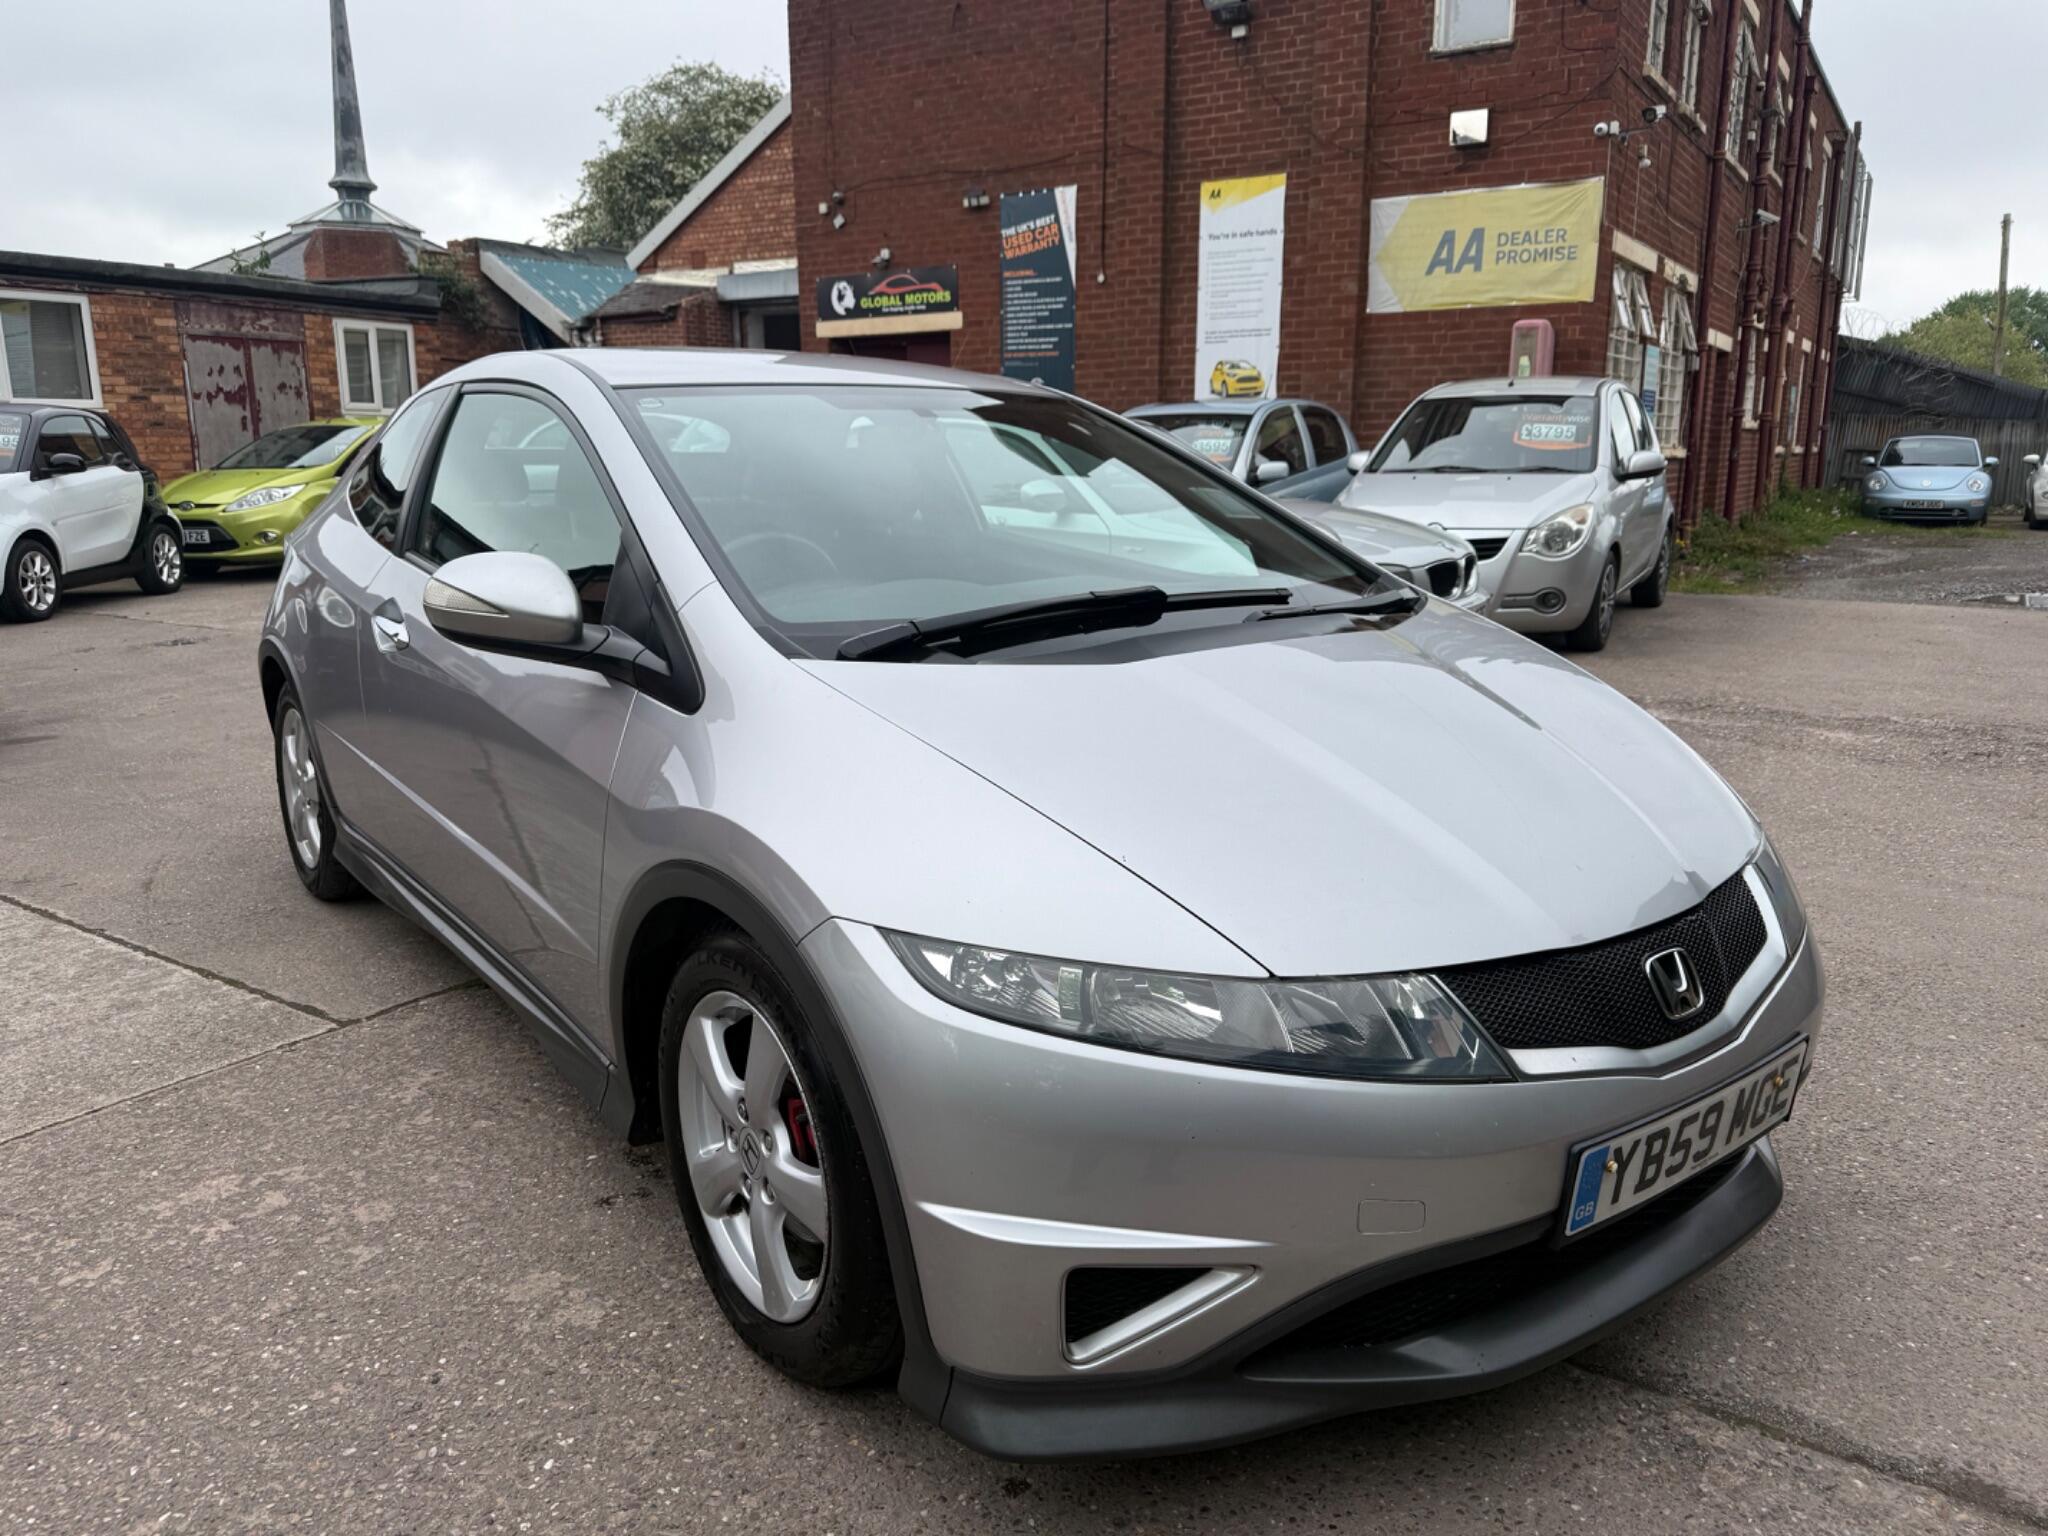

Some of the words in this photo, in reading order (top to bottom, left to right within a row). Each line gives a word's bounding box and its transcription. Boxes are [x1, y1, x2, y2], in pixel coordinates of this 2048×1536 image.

[1209, 188, 1222, 199] AA
[1001, 225, 1015, 237] THE
[1035, 213, 1056, 228] BEST
[1208, 232, 1230, 241] You're
[1239, 229, 1254, 238] safe
[1255, 227, 1278, 237] hands
[1003, 230, 1034, 249] USED
[1034, 223, 1059, 240] CAR
[1004, 232, 1060, 259] WARRANTY
[1496, 228, 1568, 247] DEALER
[1425, 227, 1486, 276] AA
[1495, 245, 1579, 266] PROMISE
[860, 296, 902, 309] GLOBAL
[905, 290, 952, 305] MOTORS
[1521, 424, 1577, 441] £3795
[1611, 1099, 1724, 1205] YB59
[1574, 1200, 1595, 1221] GB
